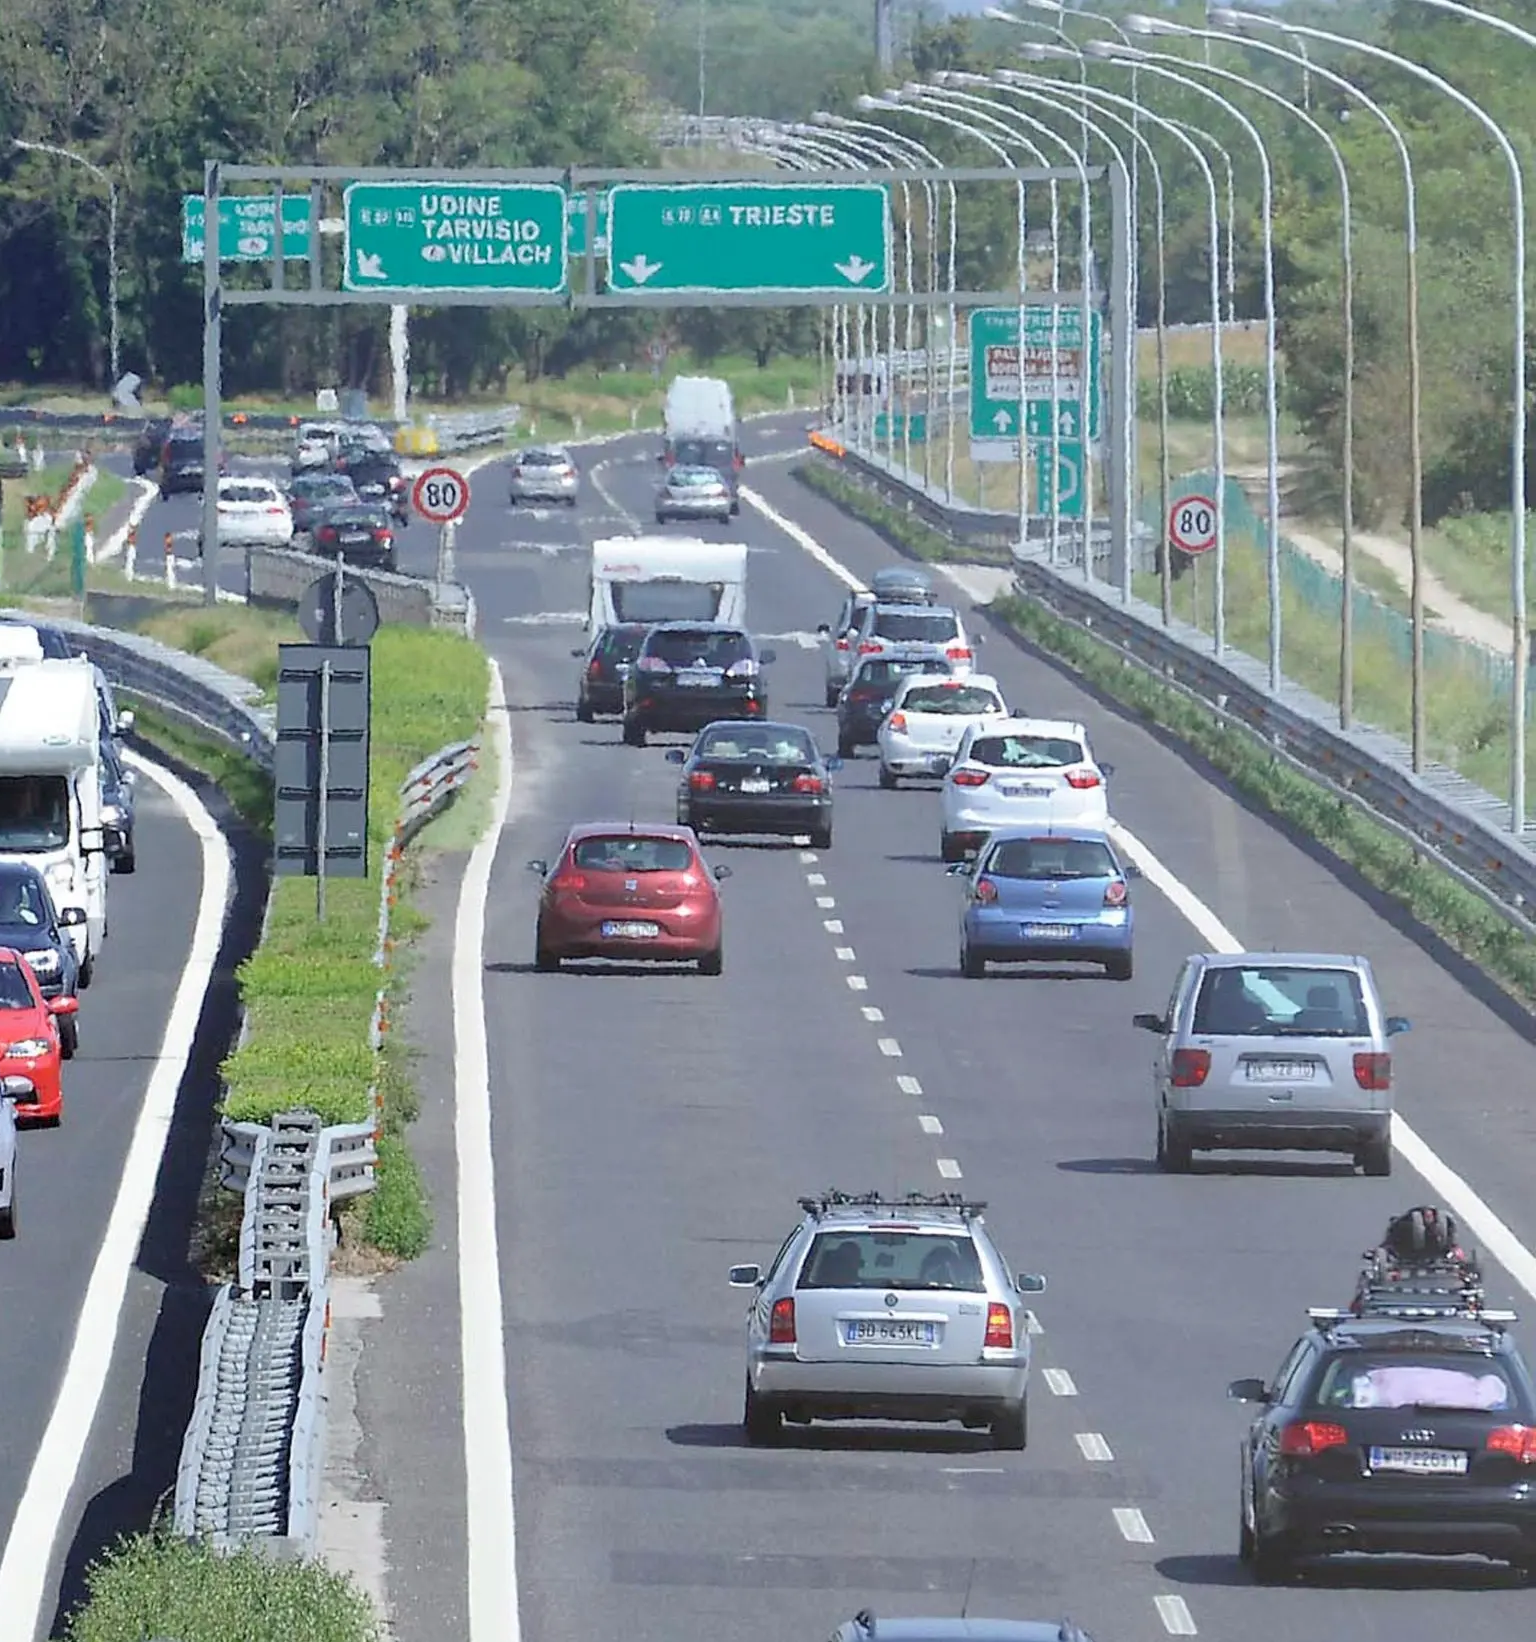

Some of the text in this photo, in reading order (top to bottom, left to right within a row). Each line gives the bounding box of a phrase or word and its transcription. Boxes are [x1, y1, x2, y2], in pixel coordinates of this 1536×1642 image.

[420, 194, 502, 217] UDINE
[729, 204, 835, 226] TRIESTE
[421, 218, 541, 242] TARVISIO
[449, 242, 552, 265] VILLACH
[426, 482, 457, 508] 80
[1180, 509, 1211, 536] 80
